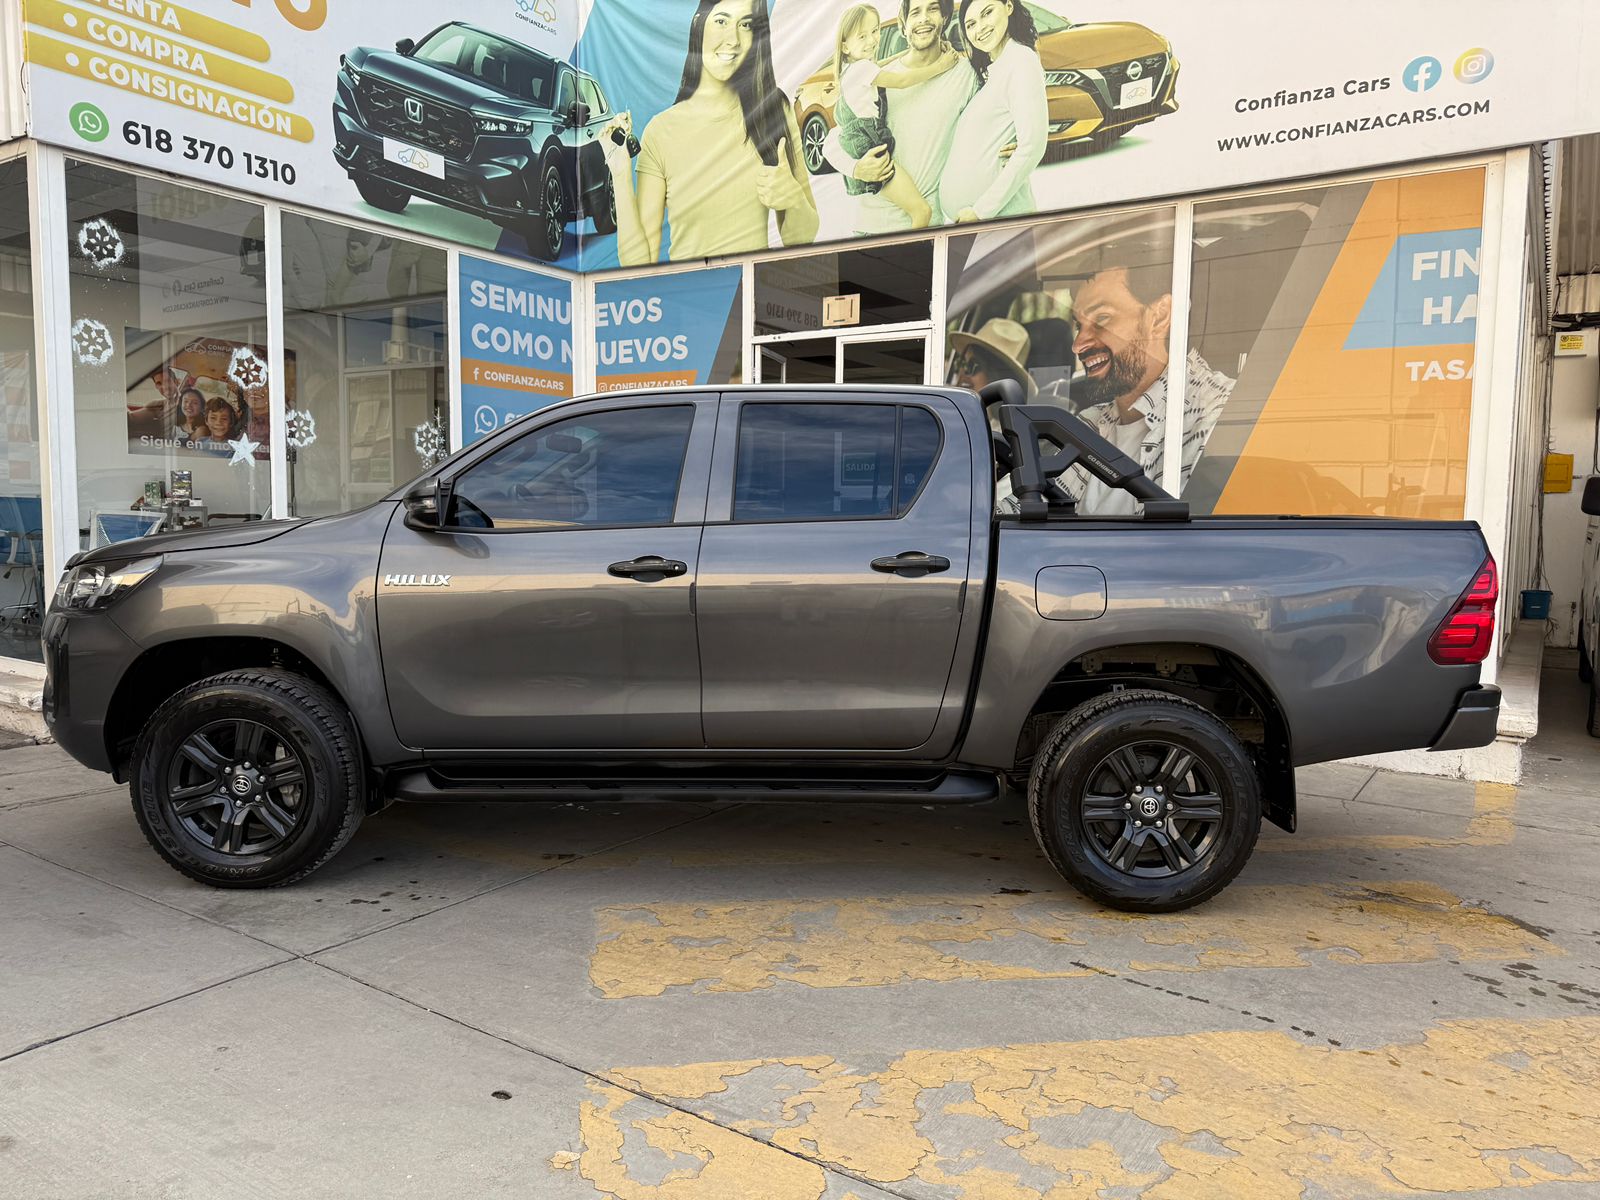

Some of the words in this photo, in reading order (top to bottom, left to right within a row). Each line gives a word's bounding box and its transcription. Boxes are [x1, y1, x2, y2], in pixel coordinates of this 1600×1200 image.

[86, 18, 209, 75] COMPRA
[89, 57, 292, 136] CONSIGNACIÓN
[1234, 84, 1336, 113] Confianza
[1343, 76, 1391, 96] Cars
[1217, 99, 1491, 152] WWW.CONFIANZACARS.COM
[122, 120, 173, 153] 618
[182, 135, 234, 169] 370
[242, 152, 297, 185] 1310
[471, 323, 553, 360] COMO
[484, 370, 565, 391] CONFIANZACARS
[140, 435, 182, 450] Sigue
[186, 440, 203, 450] en
[845, 463, 876, 472] SALIDA
[384, 573, 452, 587] HILUX
